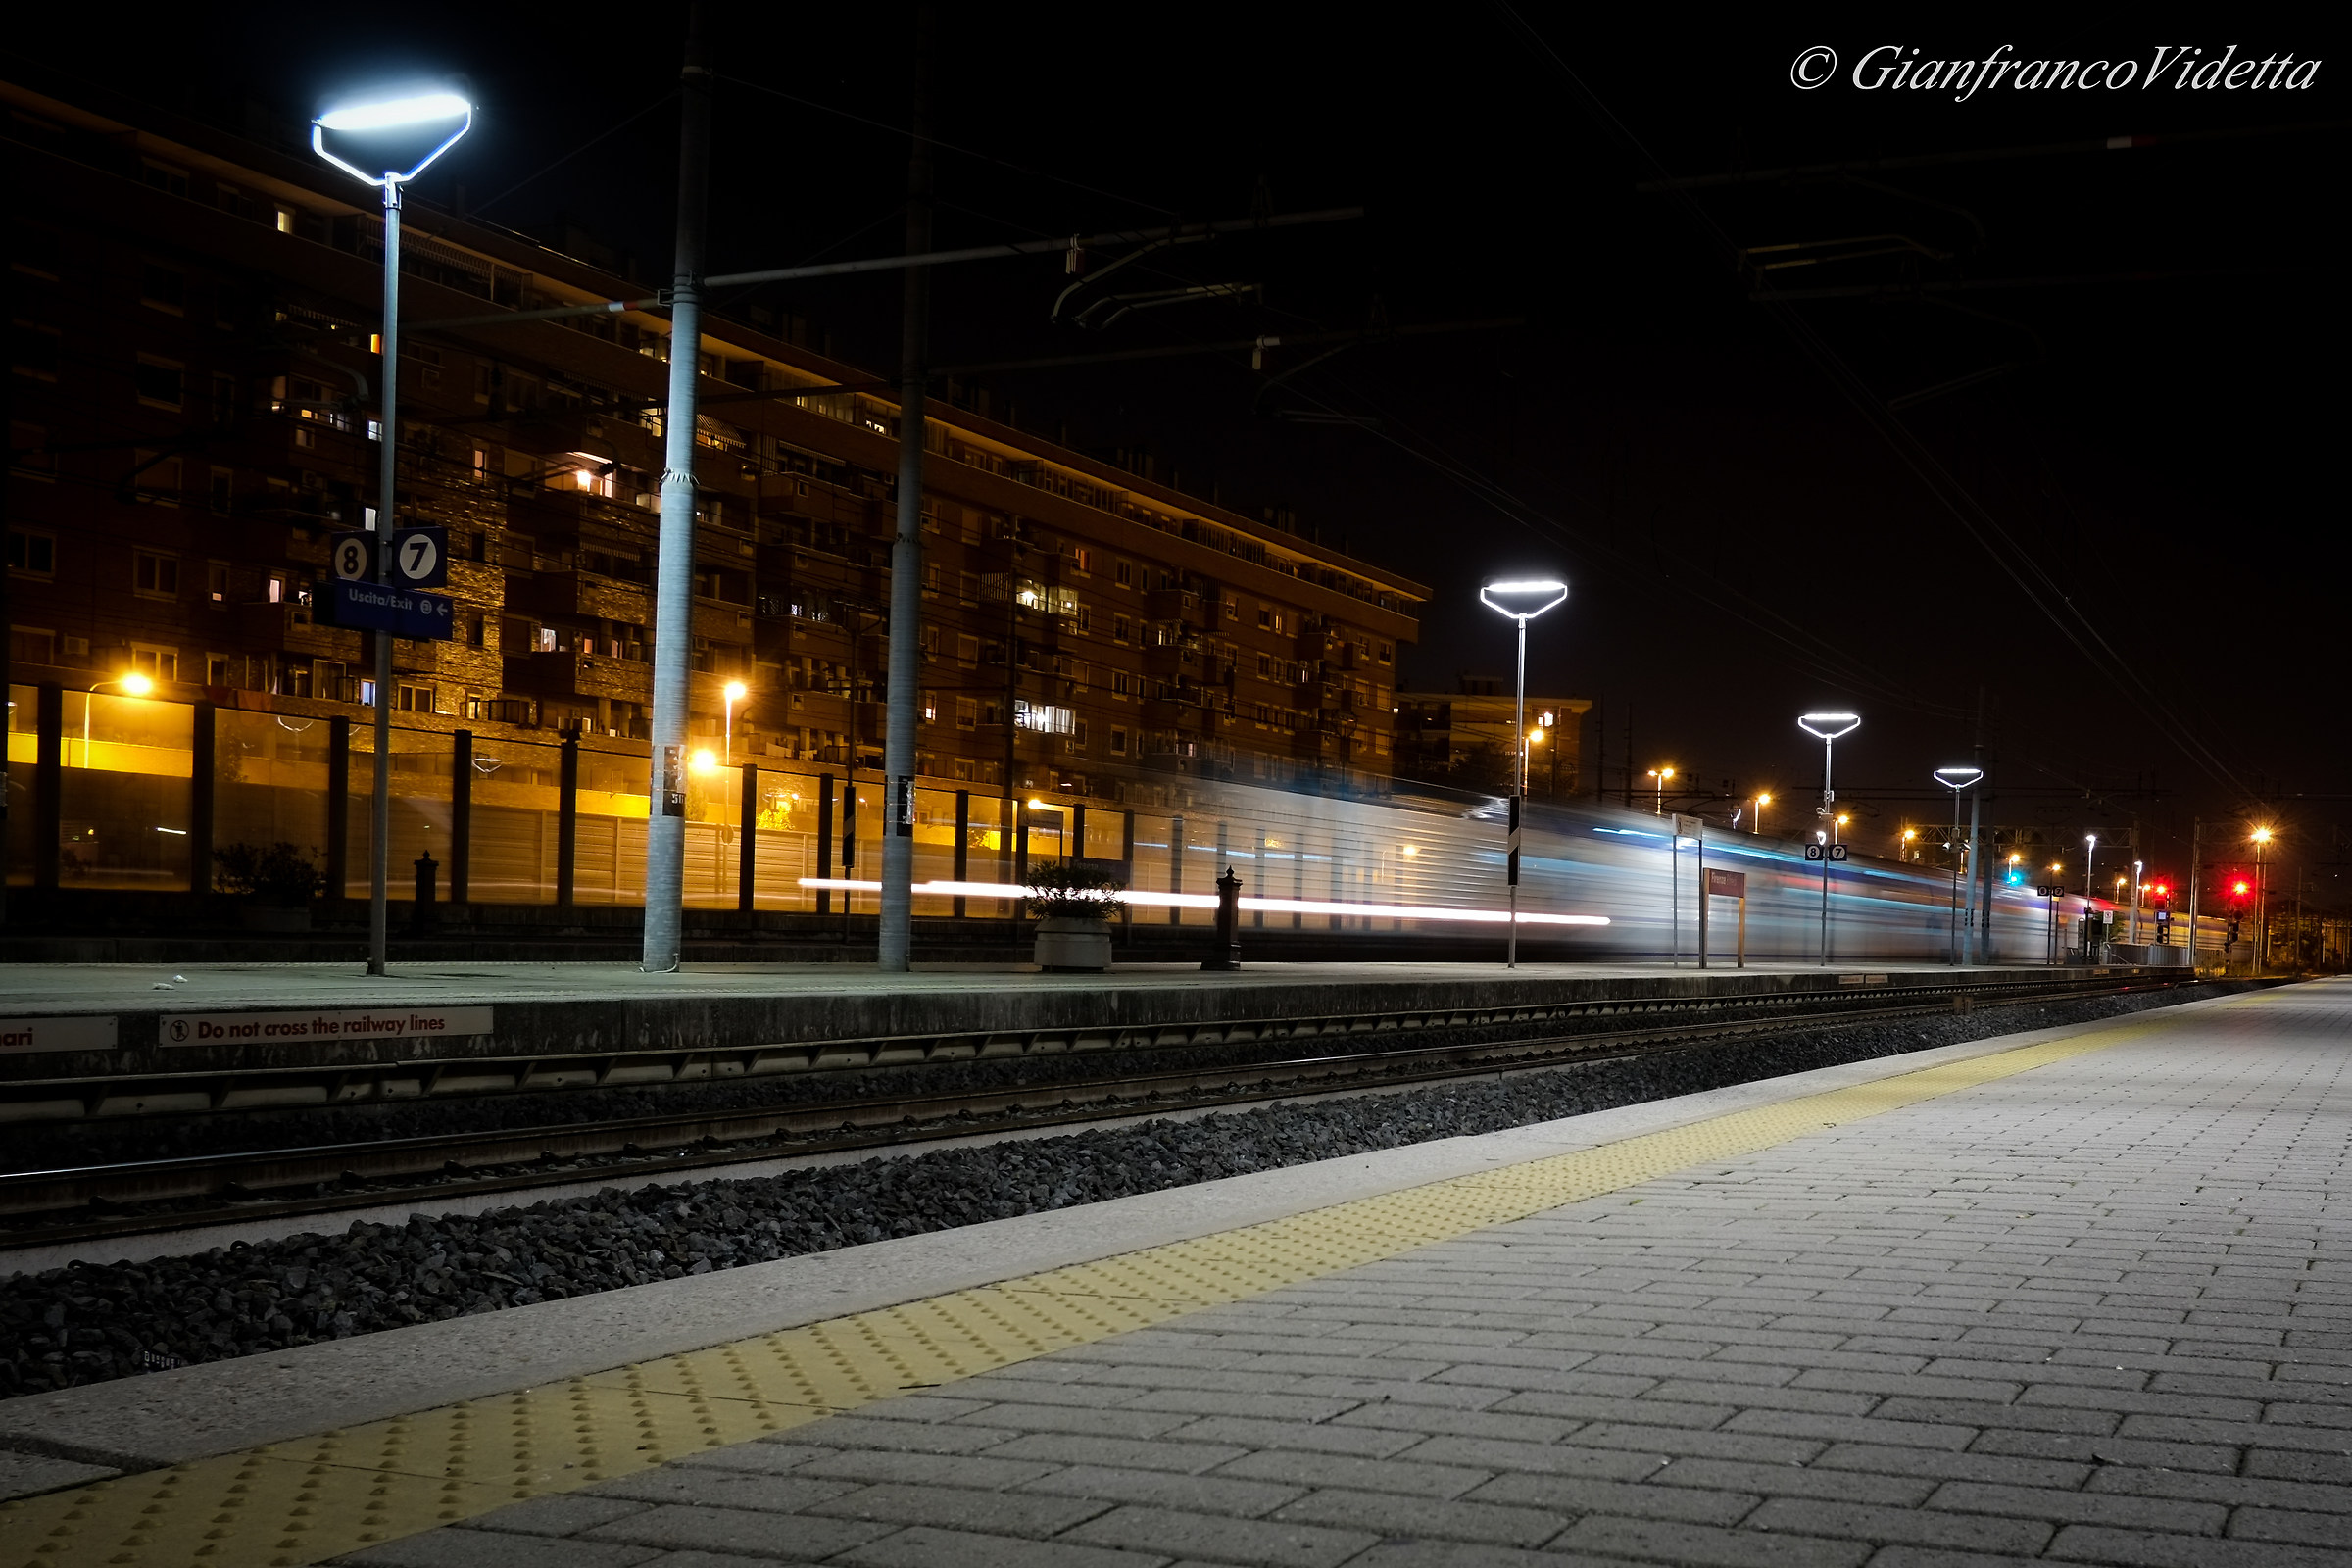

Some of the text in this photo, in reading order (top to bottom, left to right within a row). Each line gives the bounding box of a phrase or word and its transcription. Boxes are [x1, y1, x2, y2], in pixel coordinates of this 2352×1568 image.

[344, 546, 359, 574] 8
[409, 542, 429, 571] 7
[349, 589, 413, 610] Uscita/Exit
[0, 1027, 33, 1047] ari
[198, 1014, 445, 1039] Do not cross the railway lines
